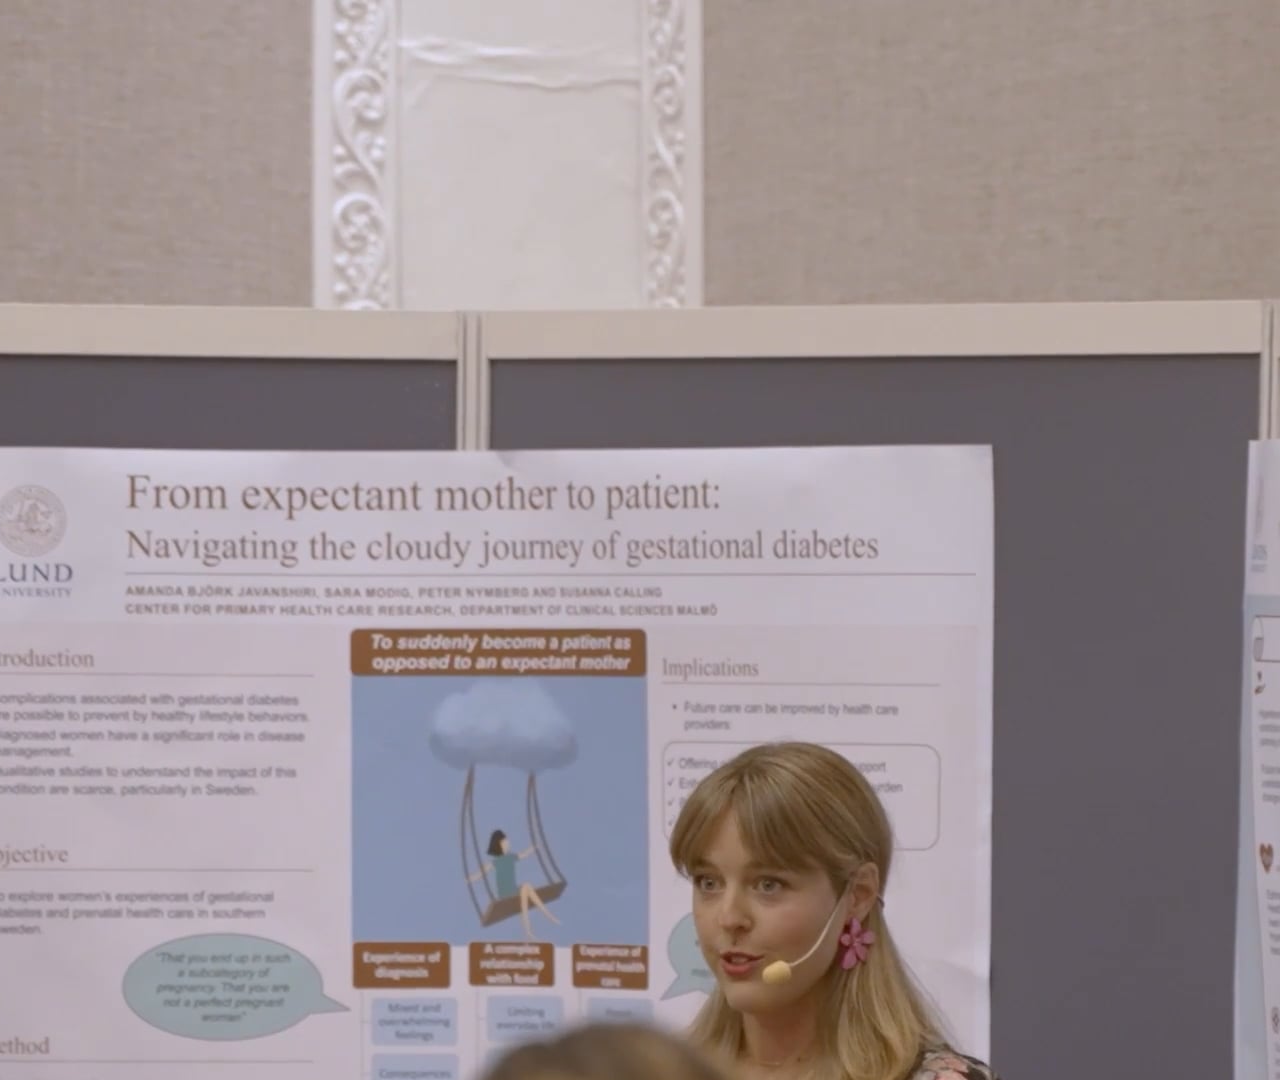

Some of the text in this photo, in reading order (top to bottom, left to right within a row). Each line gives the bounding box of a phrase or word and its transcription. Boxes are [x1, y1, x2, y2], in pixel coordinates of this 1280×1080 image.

[127, 474, 720, 520] From expectant mother to patient:
[126, 529, 879, 568] Navigating the cloudy journey of gestational diabetes
[125, 585, 184, 596] AMANDA
[187, 584, 233, 597] BJÖRK
[324, 587, 361, 598] SARA
[418, 587, 461, 598] PETER
[465, 586, 529, 598] NYMBERG
[532, 587, 556, 598] AND
[560, 587, 611, 598] SUSANNA
[614, 587, 662, 598] CALLING
[125, 603, 180, 615] CENTER
[184, 603, 211, 615] FOR
[216, 604, 275, 615] PRIMARY
[280, 604, 332, 616] HEALTH
[336, 605, 373, 616] CARE
[460, 605, 544, 616] DEPARTMENT
[547, 604, 562, 616] OF
[565, 604, 616, 616] CLINICAL
[619, 605, 674, 616] SCIENCES
[676, 603, 717, 616] MALMÖ
[371, 633, 631, 655] To suddenly become a patient as
[372, 654, 631, 673] opposed to an expectant mother
[662, 658, 759, 681] Implications
[80, 693, 147, 705] associated
[149, 694, 175, 704] with
[177, 693, 244, 709] gestational
[246, 695, 299, 706] diabetes
